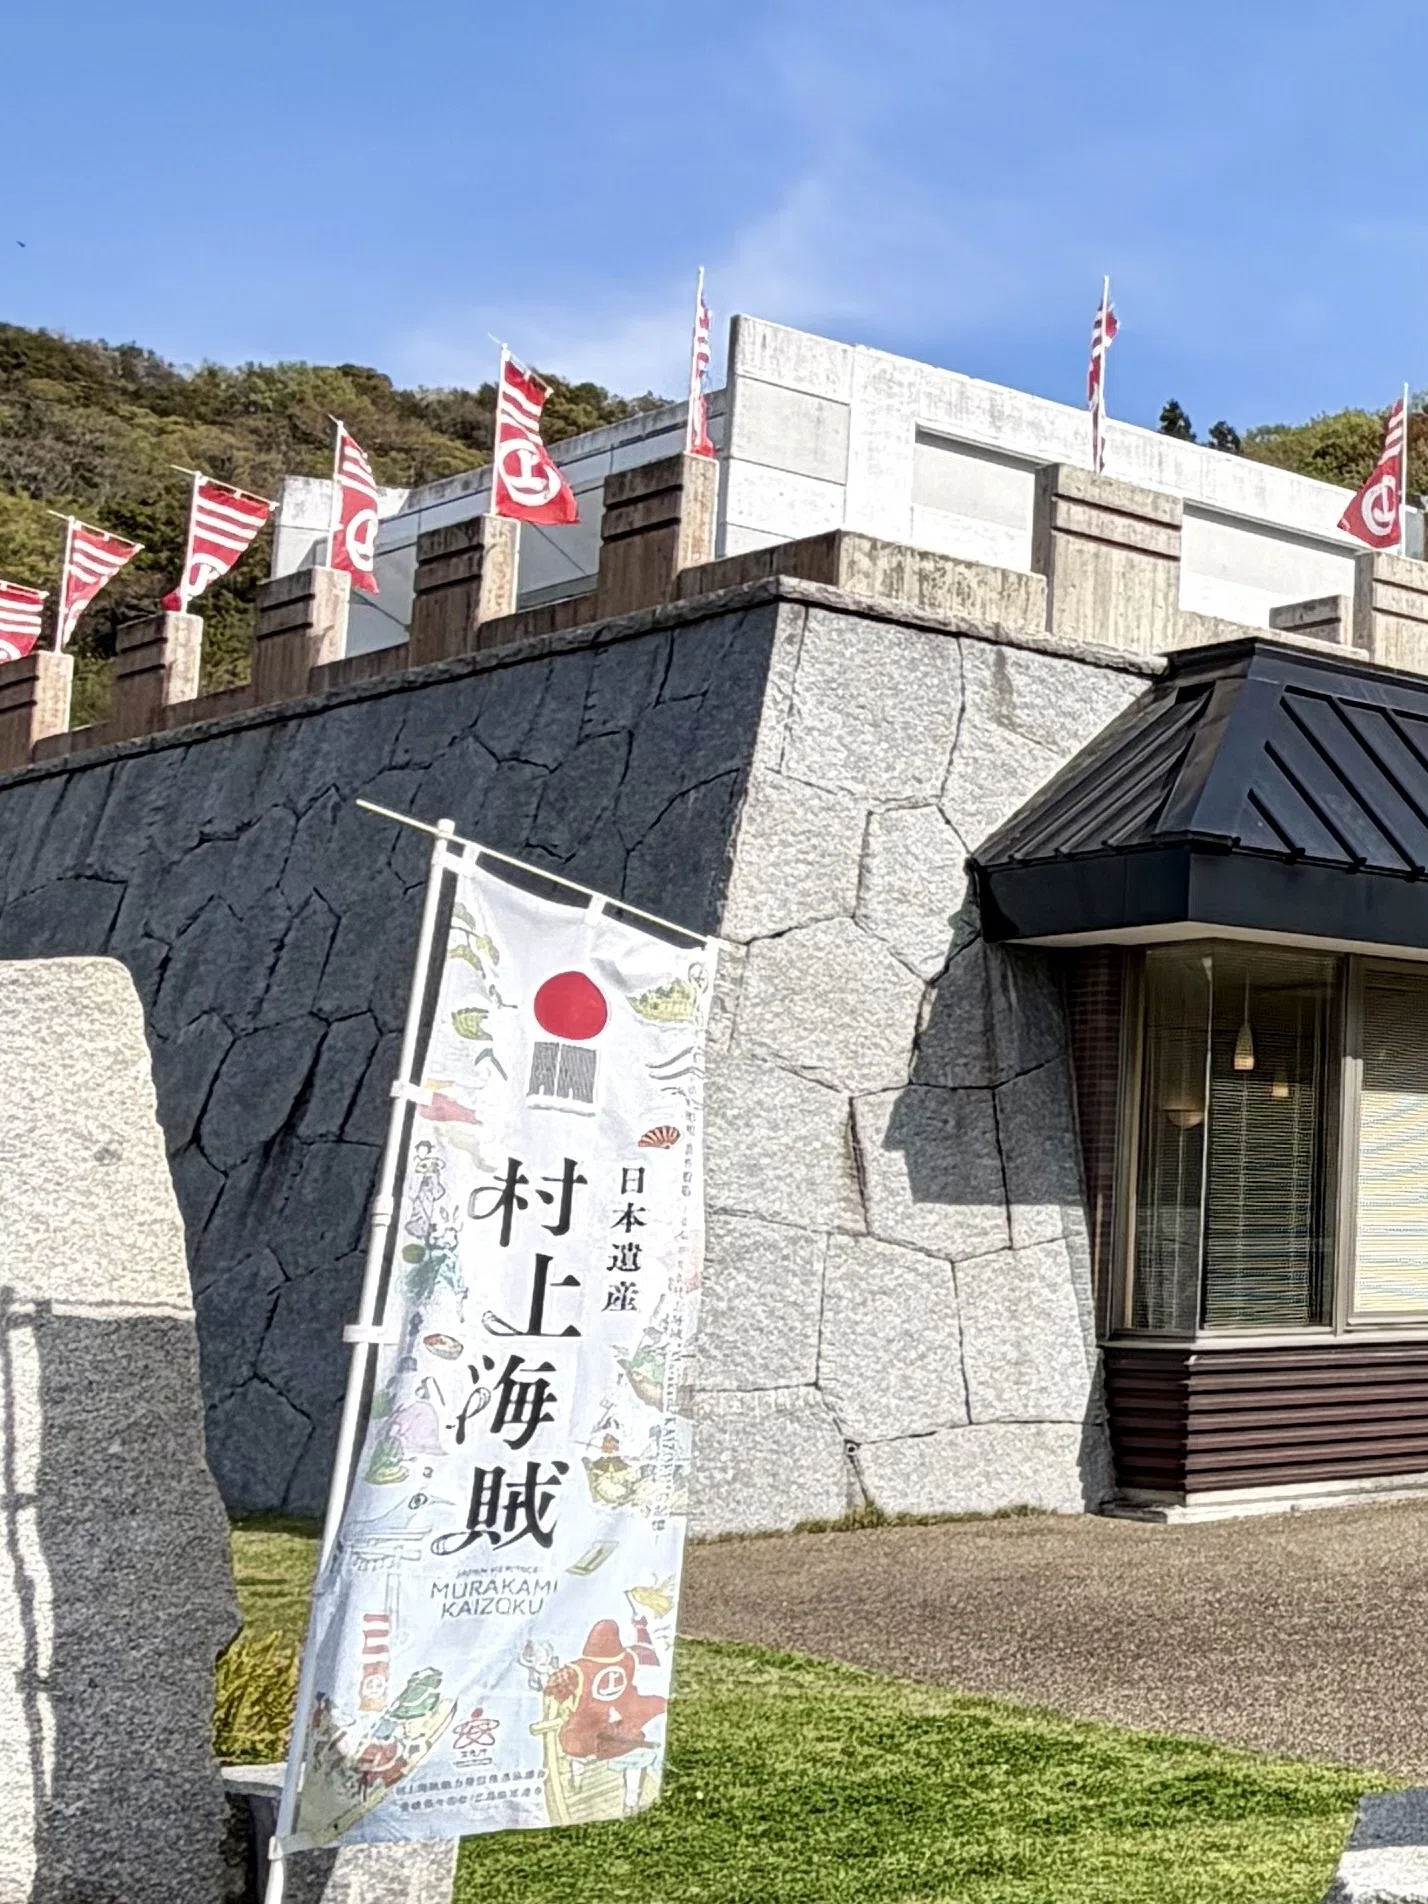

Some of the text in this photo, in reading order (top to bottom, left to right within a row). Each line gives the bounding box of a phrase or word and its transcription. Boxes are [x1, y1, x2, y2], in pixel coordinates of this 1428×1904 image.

[601, 1166, 648, 1312] 日本遺産
[431, 1157, 588, 1555] 村上海賊
[430, 1578, 558, 1599] MURAKAMI
[441, 1597, 544, 1619] KAIZOKU
